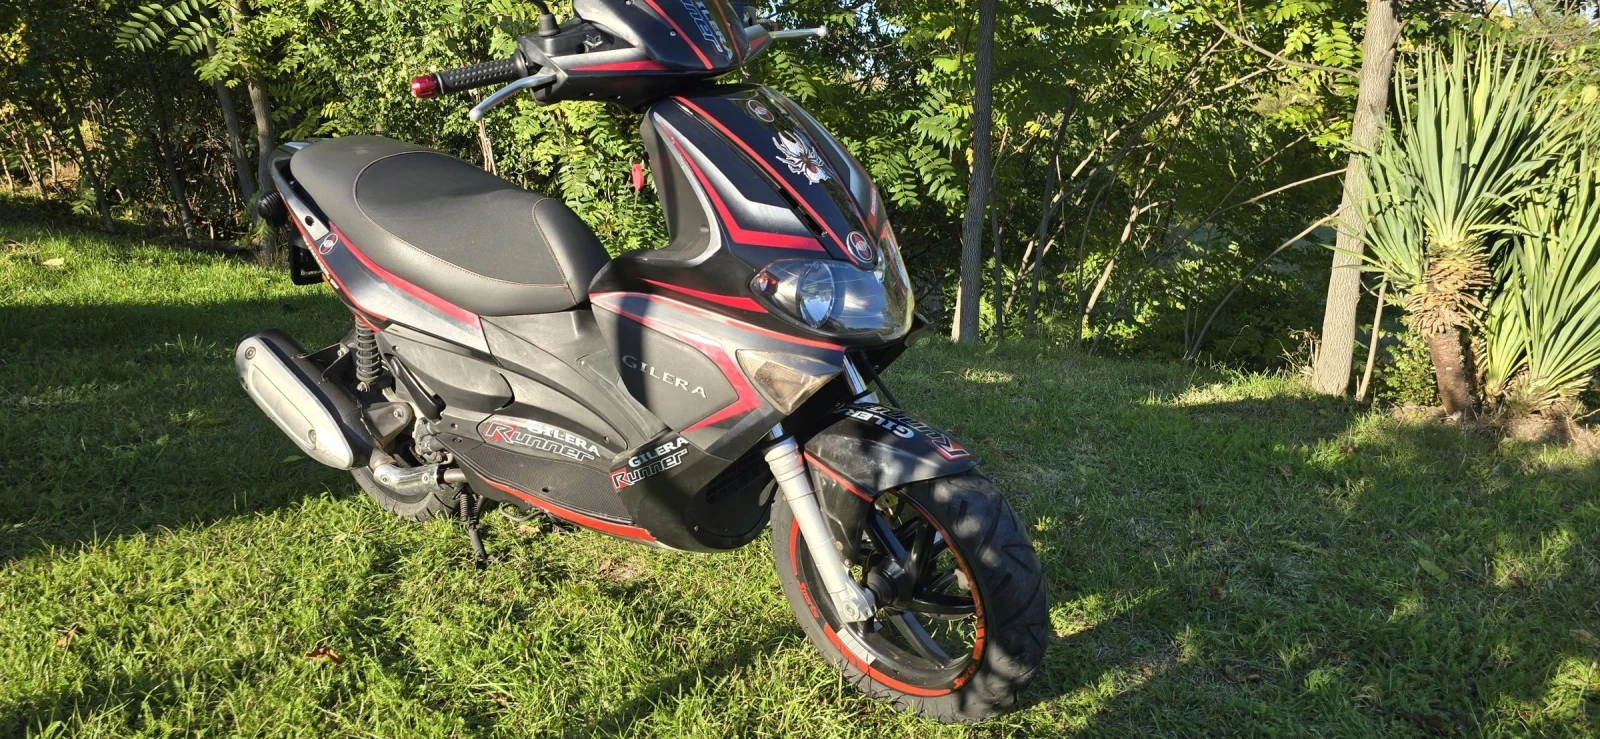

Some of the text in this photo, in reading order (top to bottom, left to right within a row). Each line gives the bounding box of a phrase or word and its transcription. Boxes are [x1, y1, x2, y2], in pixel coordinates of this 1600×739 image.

[622, 355, 707, 399] GILERA
[485, 421, 595, 462] Runner
[525, 420, 601, 457] GILERA
[628, 436, 689, 468] GILERA
[612, 448, 688, 489] Runner
